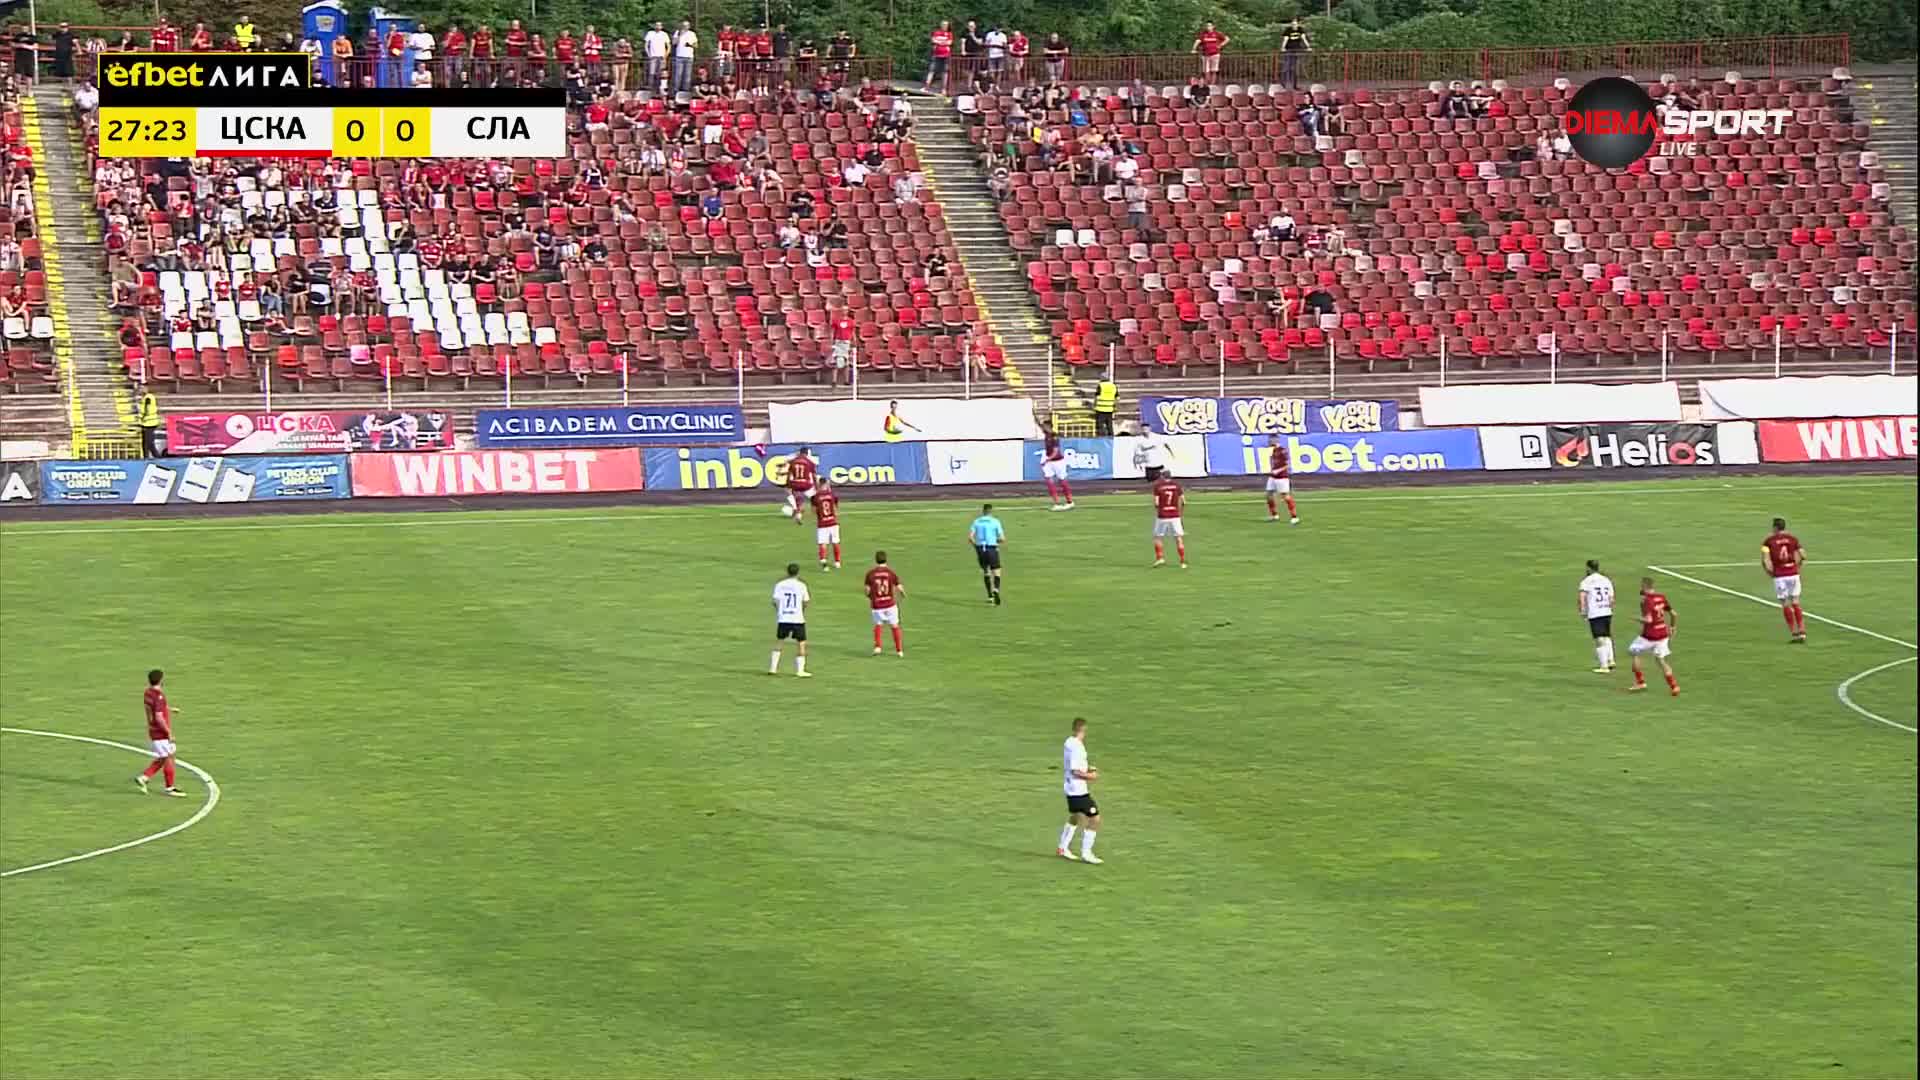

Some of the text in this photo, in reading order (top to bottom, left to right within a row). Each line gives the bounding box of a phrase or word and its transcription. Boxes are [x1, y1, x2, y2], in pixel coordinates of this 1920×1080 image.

[256, 413, 336, 433] ЦСКА
[488, 416, 617, 434] ACIBADEM
[1589, 432, 1715, 467] Helios
[392, 450, 598, 495] WINBET
[677, 447, 896, 489] inbecom
[794, 464, 806, 480] 11
[1164, 490, 1174, 505] 7
[822, 501, 831, 516] 8
[1778, 545, 1789, 561] 4
[784, 592, 798, 609] 71
